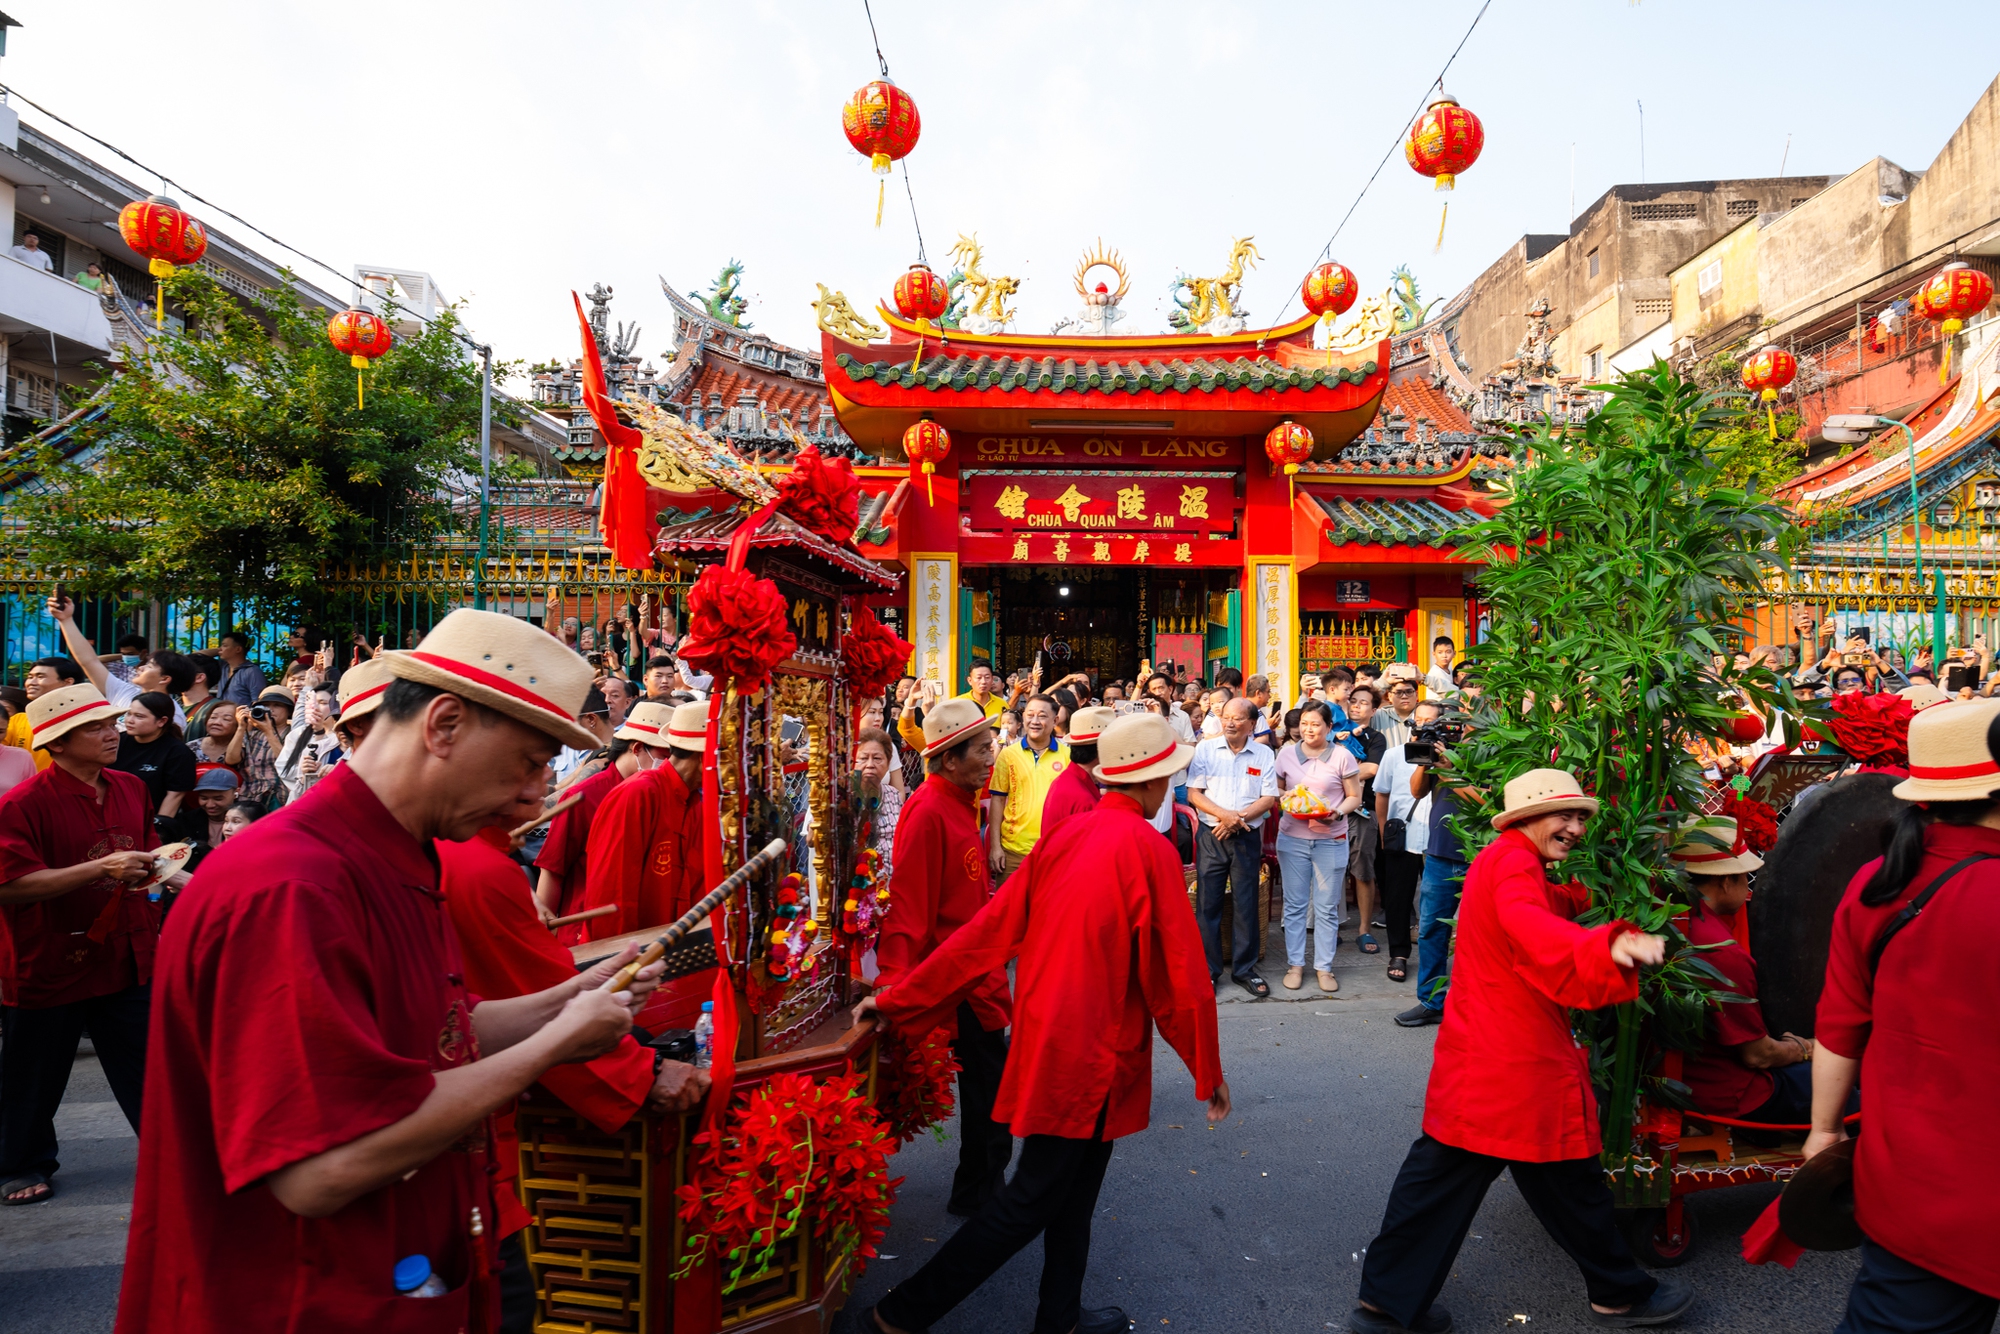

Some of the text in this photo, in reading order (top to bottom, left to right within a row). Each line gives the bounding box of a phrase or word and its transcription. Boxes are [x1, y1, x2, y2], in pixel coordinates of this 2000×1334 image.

[1140, 437, 1229, 457] LĂNG
[1027, 511, 1174, 529] CHÙA QUAN ÂM
[1343, 582, 1363, 594] 12
